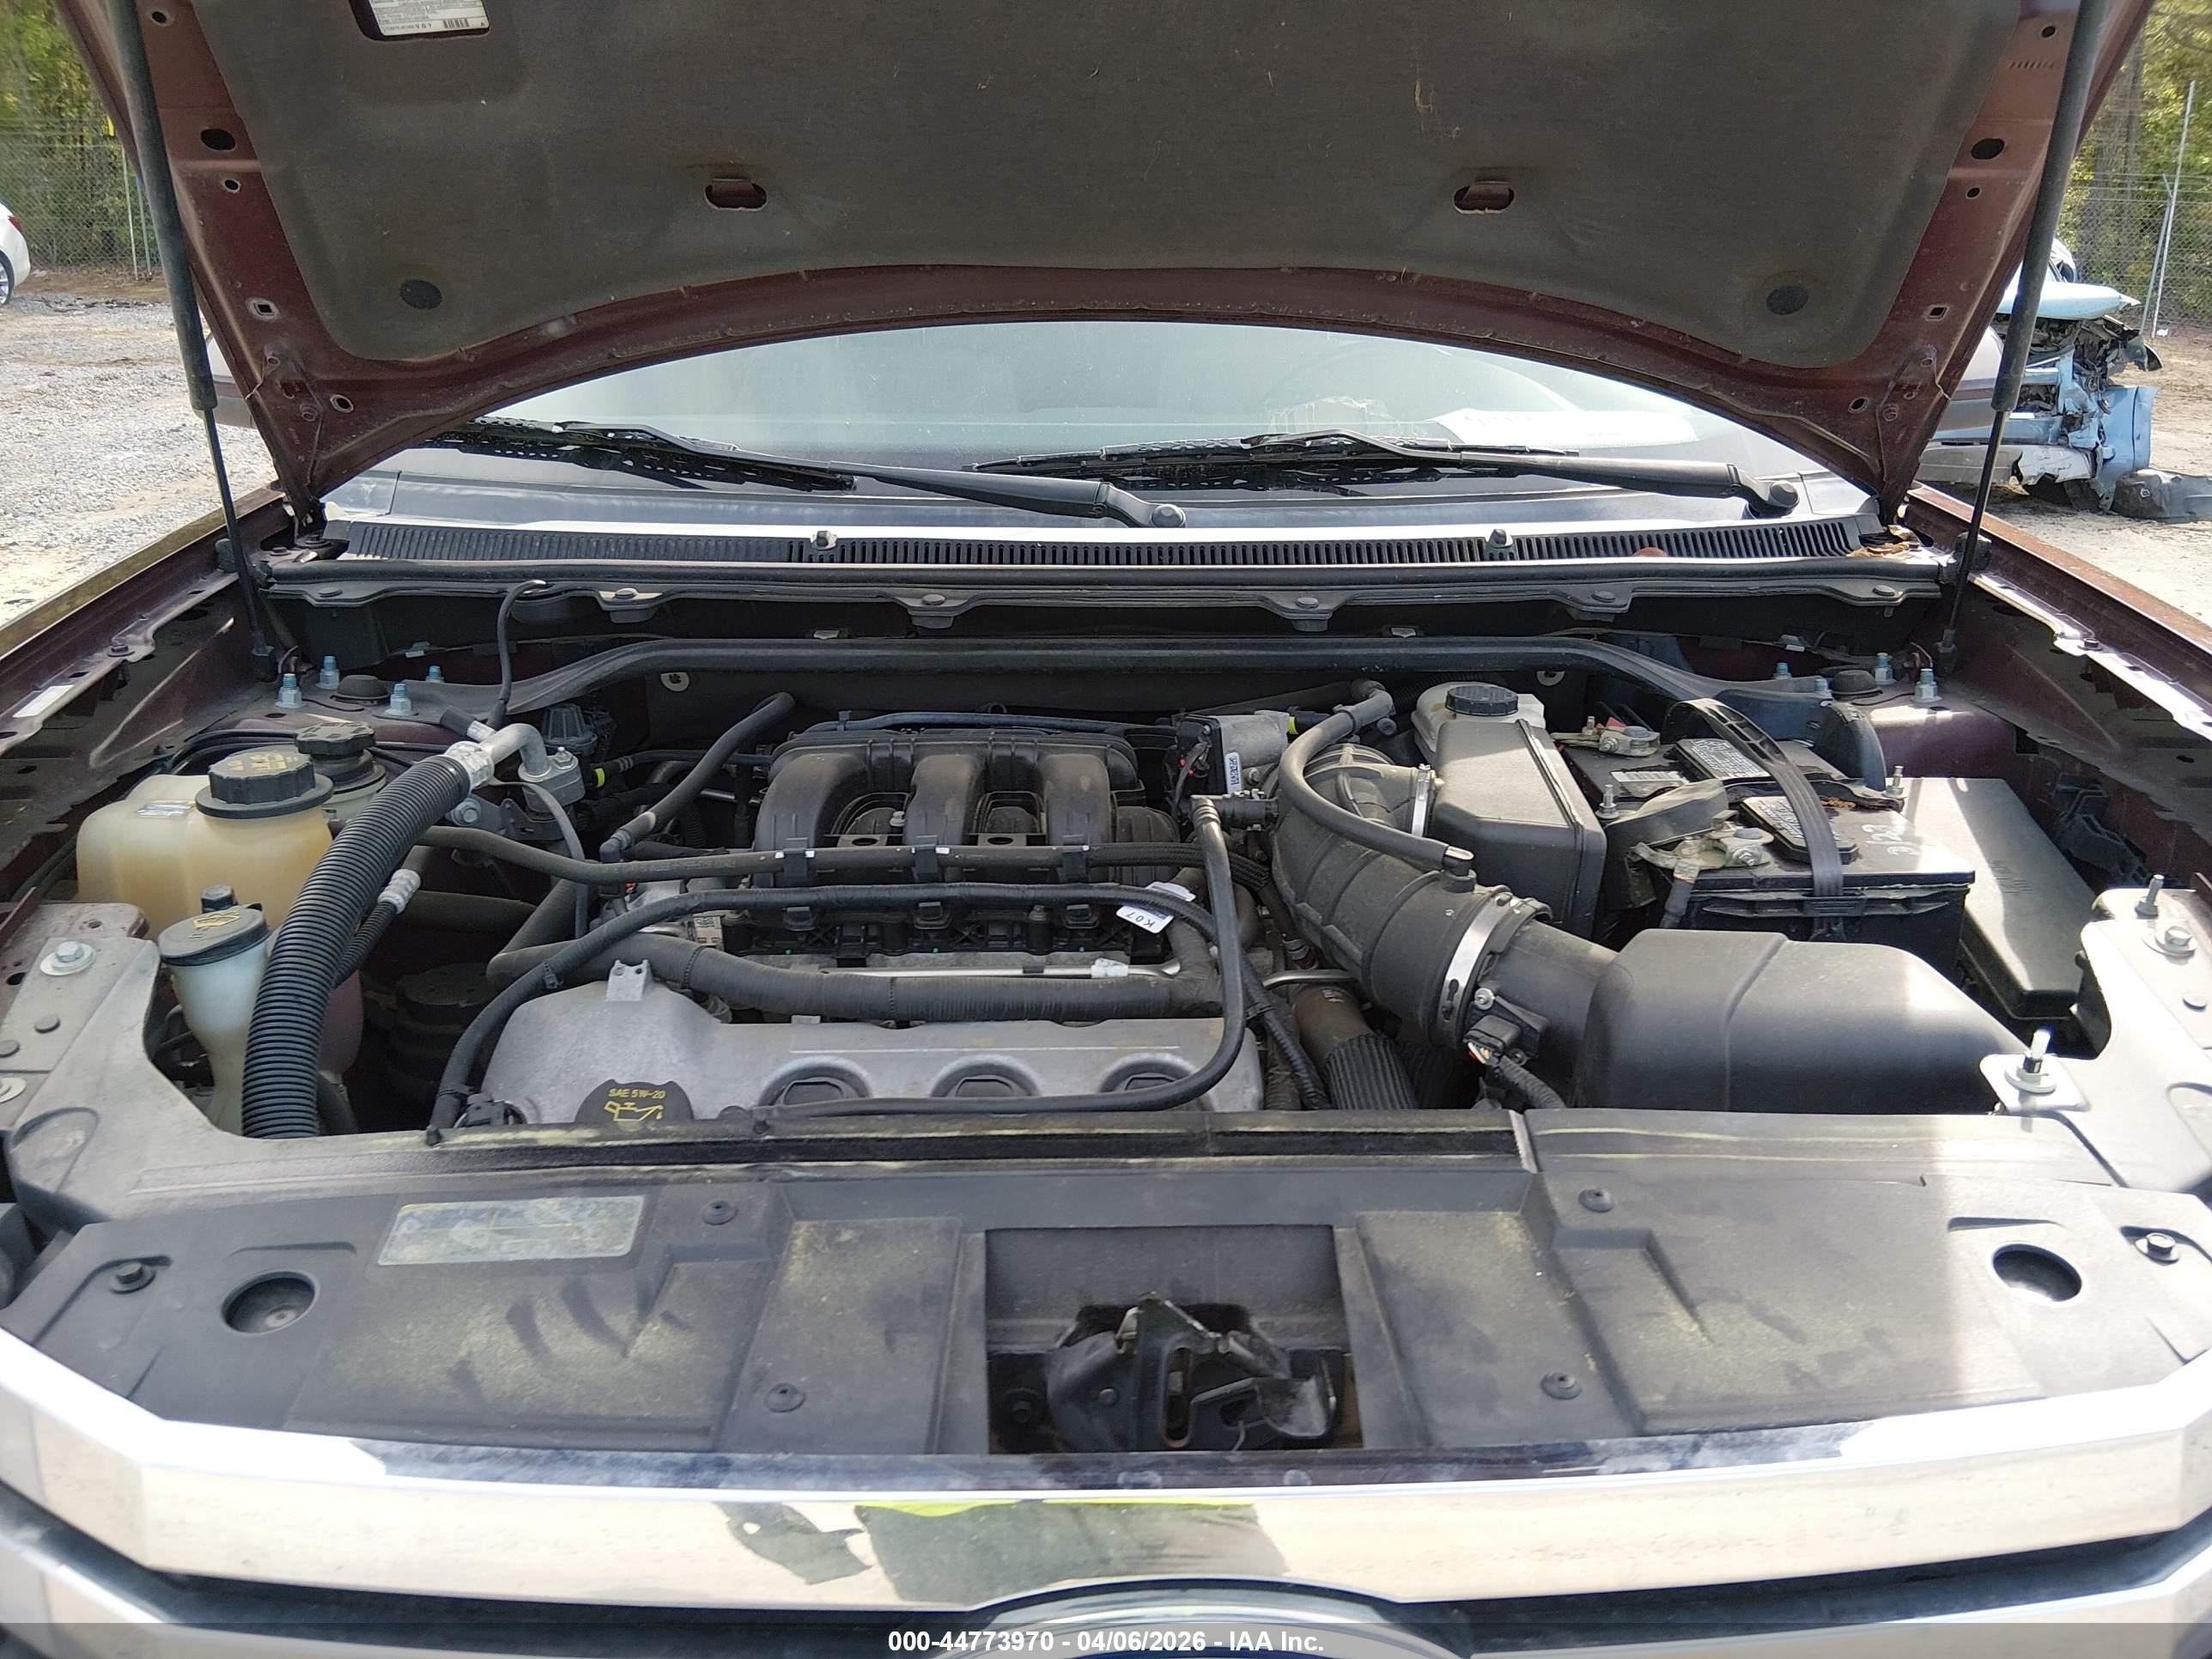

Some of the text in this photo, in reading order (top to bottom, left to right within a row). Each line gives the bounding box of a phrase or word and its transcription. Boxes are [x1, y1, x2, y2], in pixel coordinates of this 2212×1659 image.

[1126, 911, 1156, 927] K07
[608, 1088, 666, 1100] SAE 5W-20
